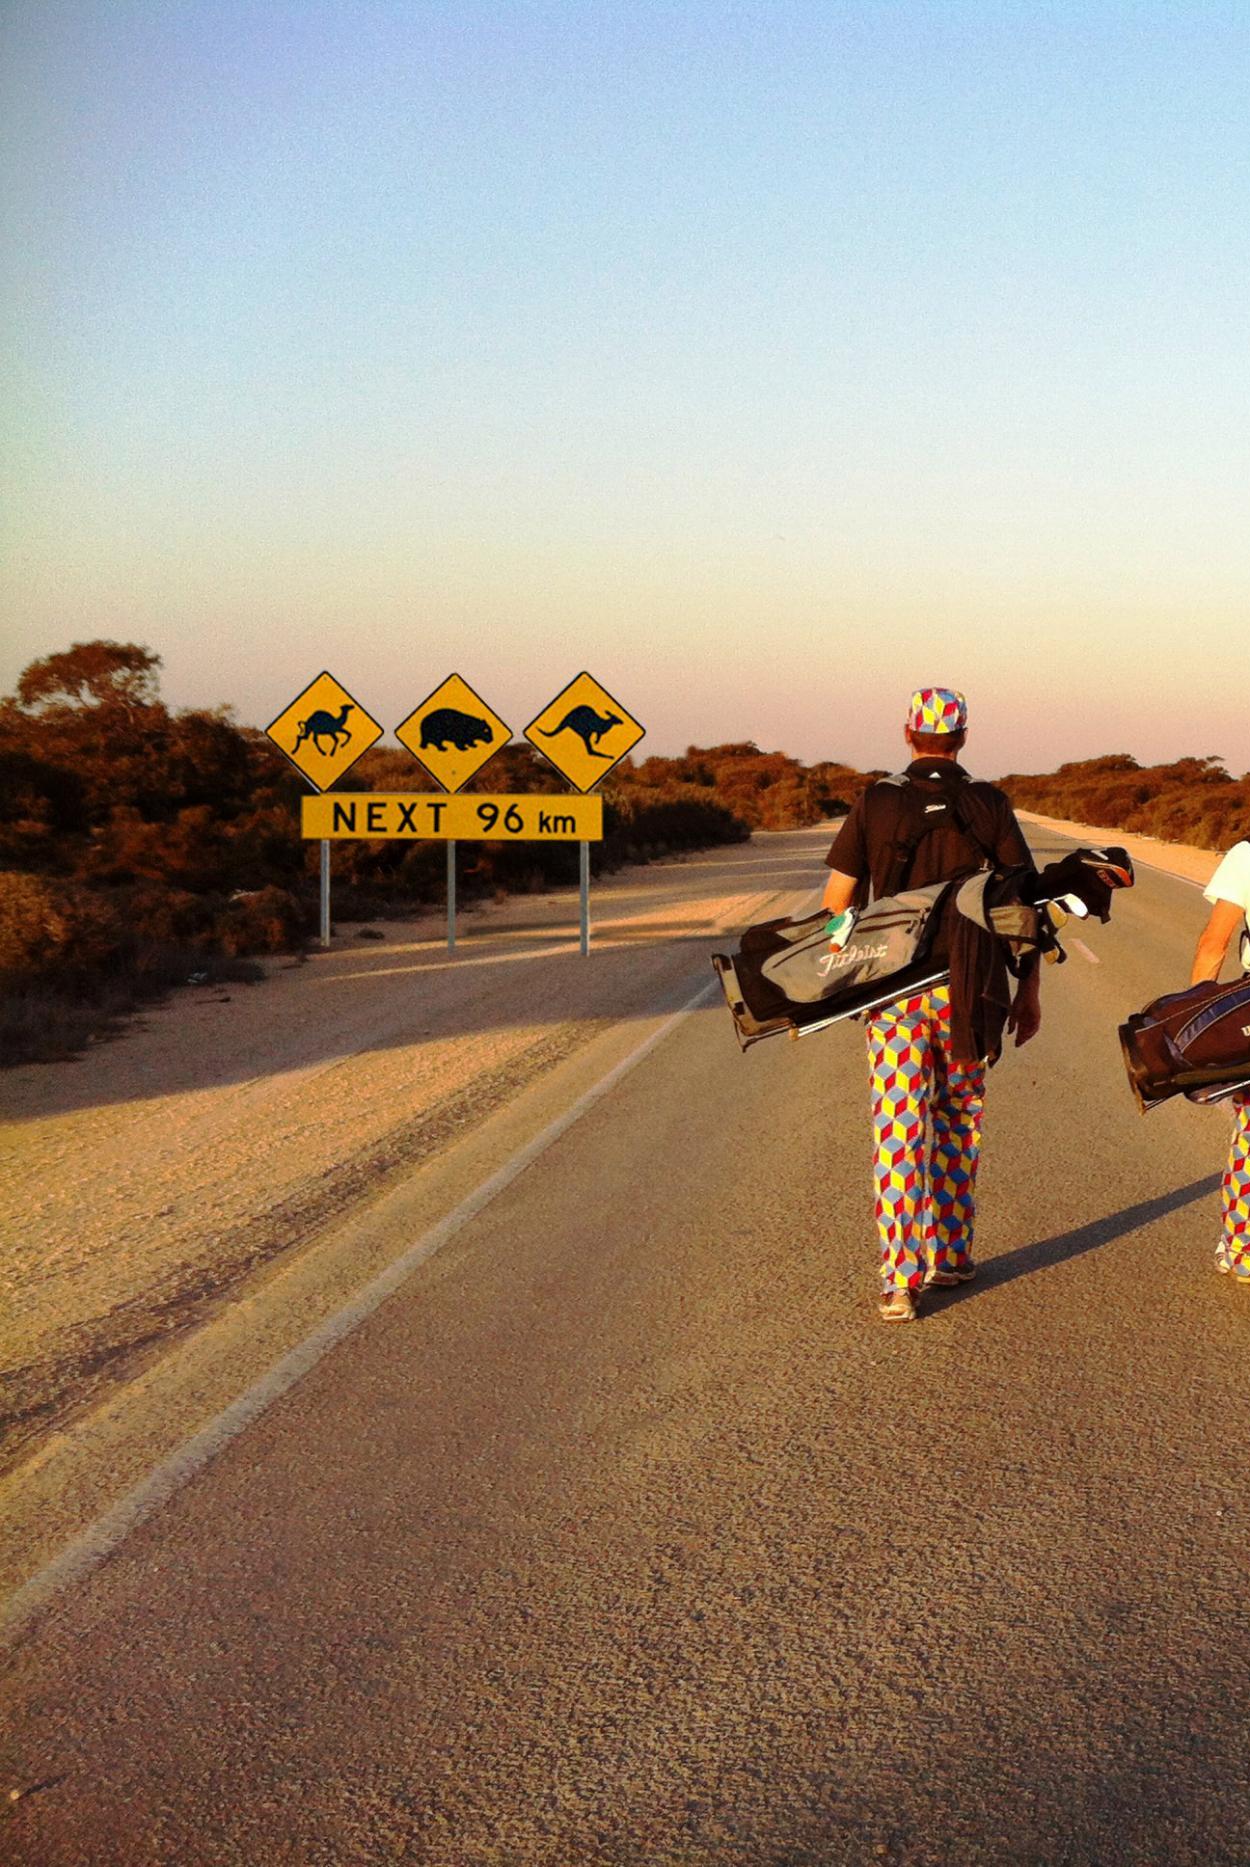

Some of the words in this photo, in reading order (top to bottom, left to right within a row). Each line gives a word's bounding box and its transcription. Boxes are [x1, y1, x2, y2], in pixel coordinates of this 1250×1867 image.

[333, 802, 447, 832] NEXT
[476, 802, 524, 834] 96
[538, 810, 576, 833] km
[816, 944, 889, 977] Titleist
